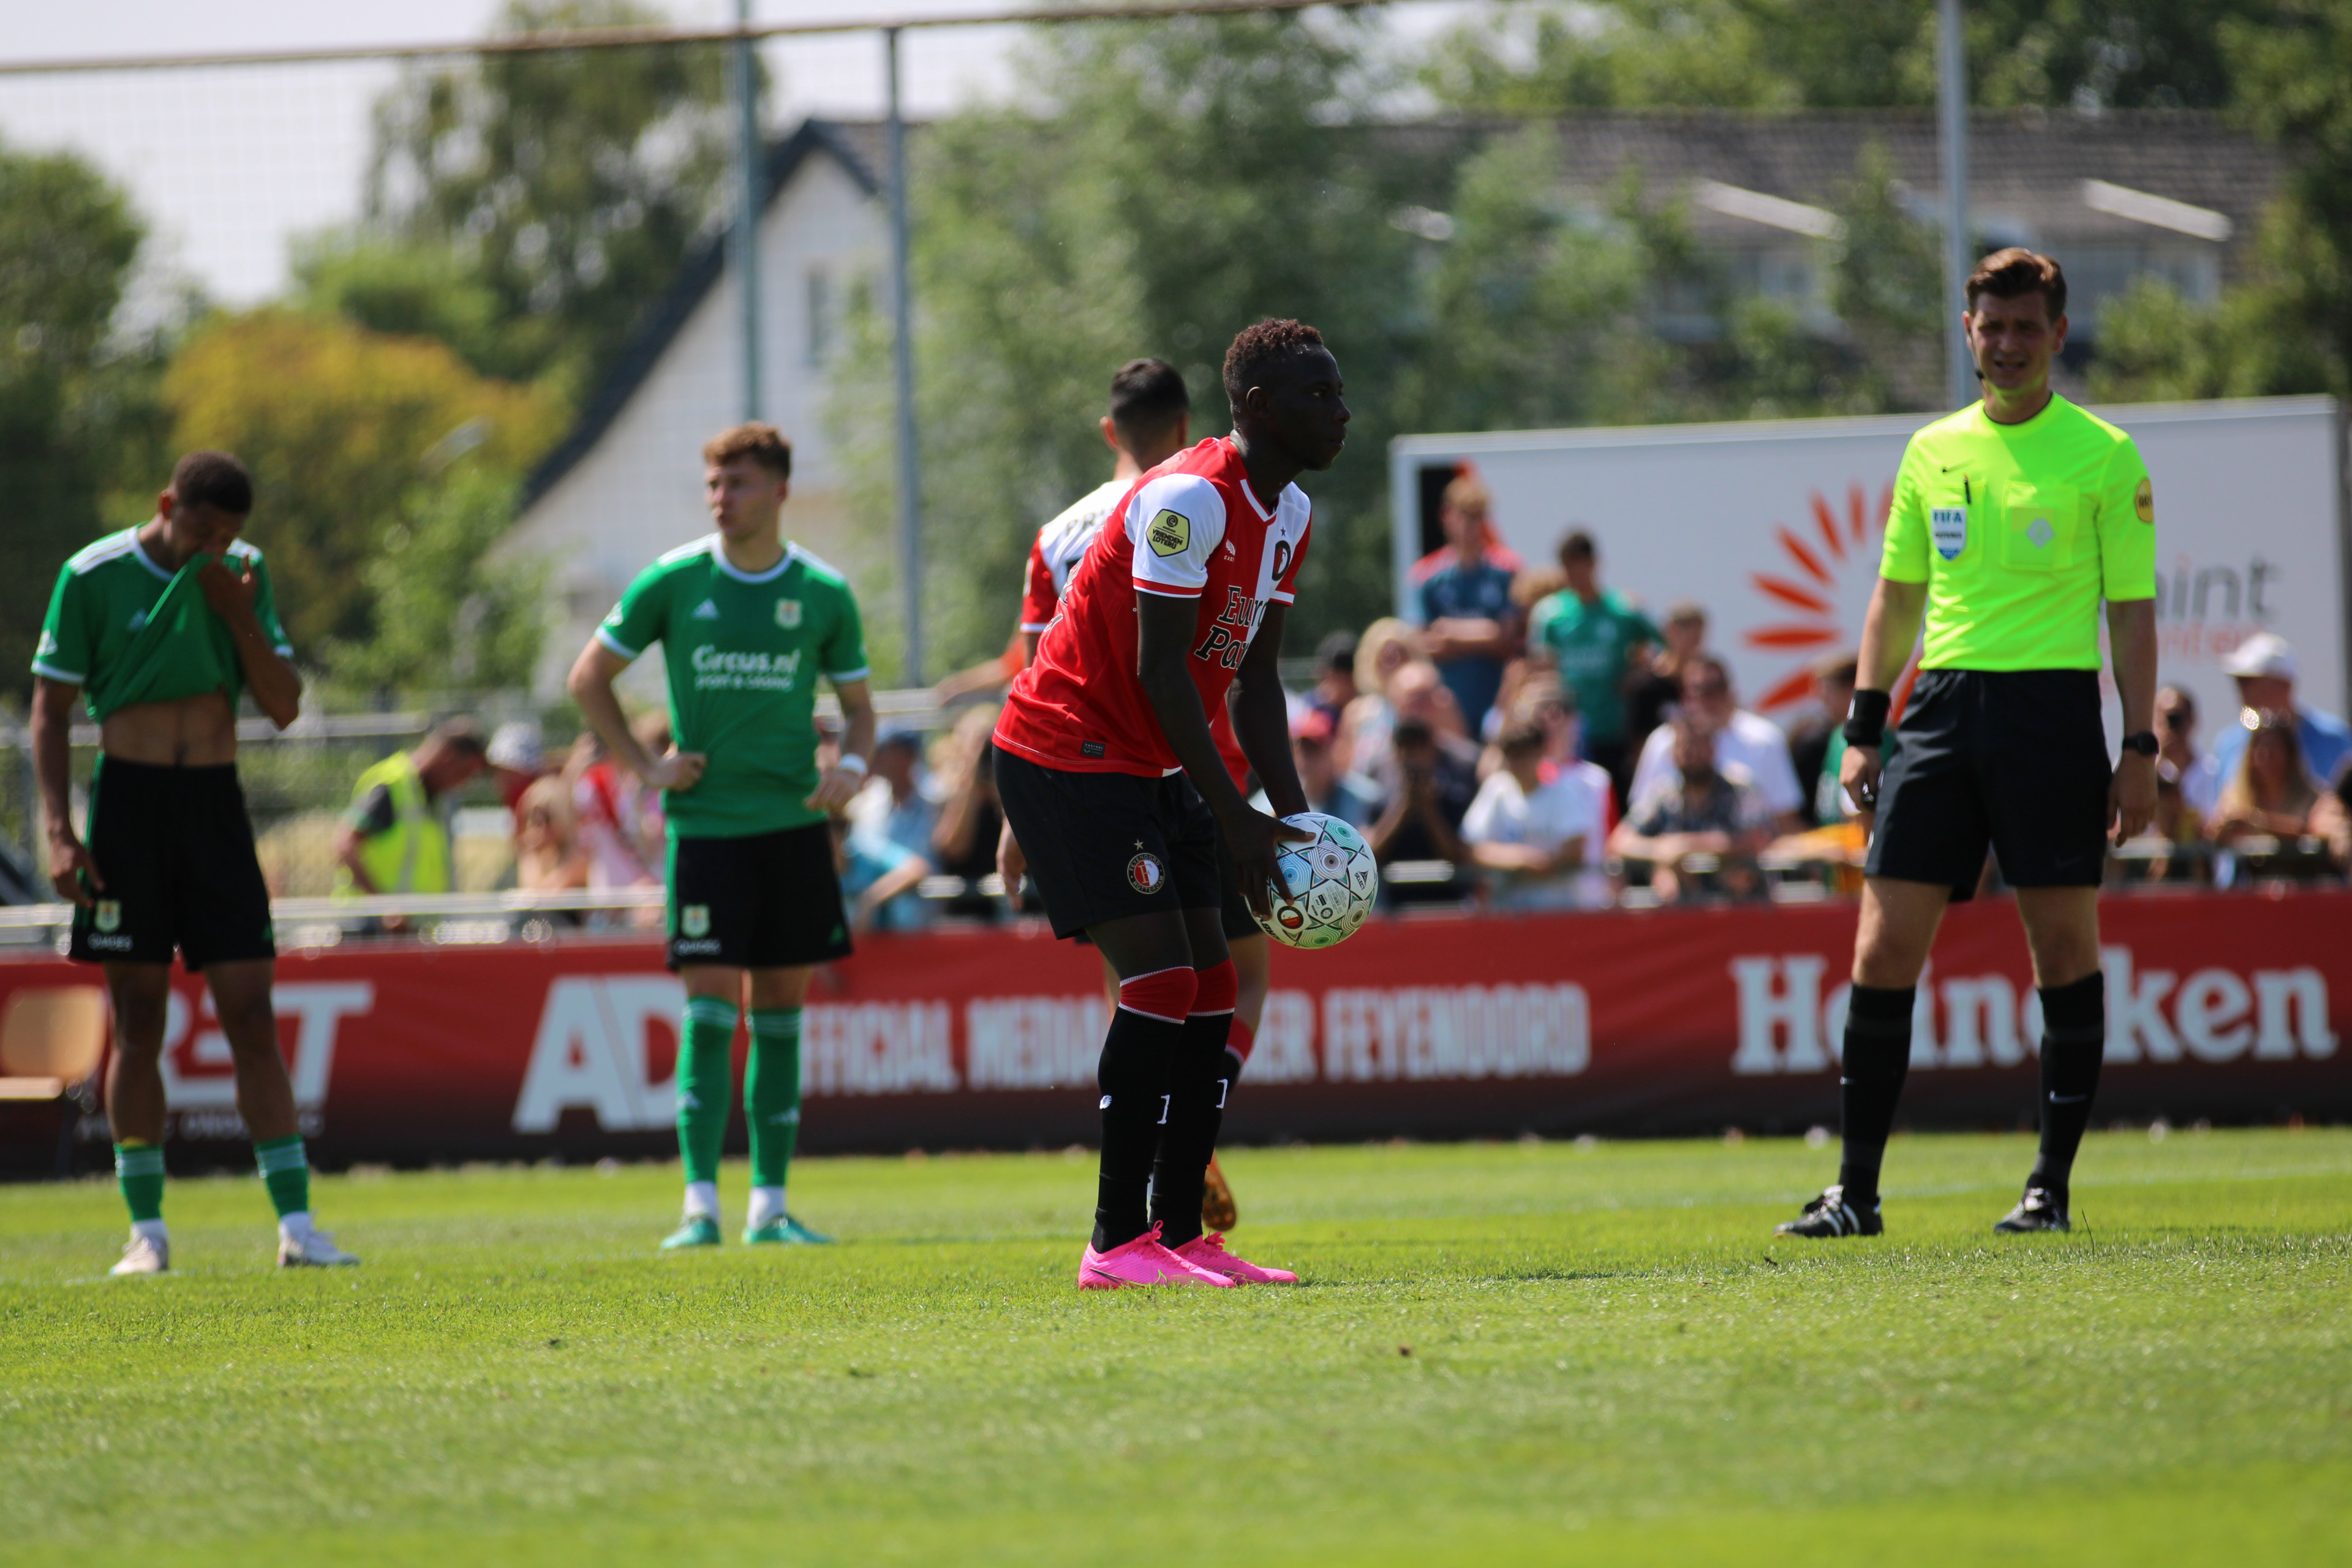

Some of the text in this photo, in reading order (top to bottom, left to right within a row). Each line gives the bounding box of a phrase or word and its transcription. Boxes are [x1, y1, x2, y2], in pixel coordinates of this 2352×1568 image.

[1934, 511, 1962, 523] FIFA
[1152, 529, 1183, 545] VRIENDEN
[1129, 854, 1160, 872] FEYENOORD
[1132, 875, 1163, 892] ROTTERDAM
[1354, 872, 1365, 891] SELECT
[1729, 945, 2340, 1076] Hinken
[800, 1000, 960, 1096] FFICIAL
[1322, 981, 1593, 1082] FEYENOORD
[510, 974, 681, 1133] AD
